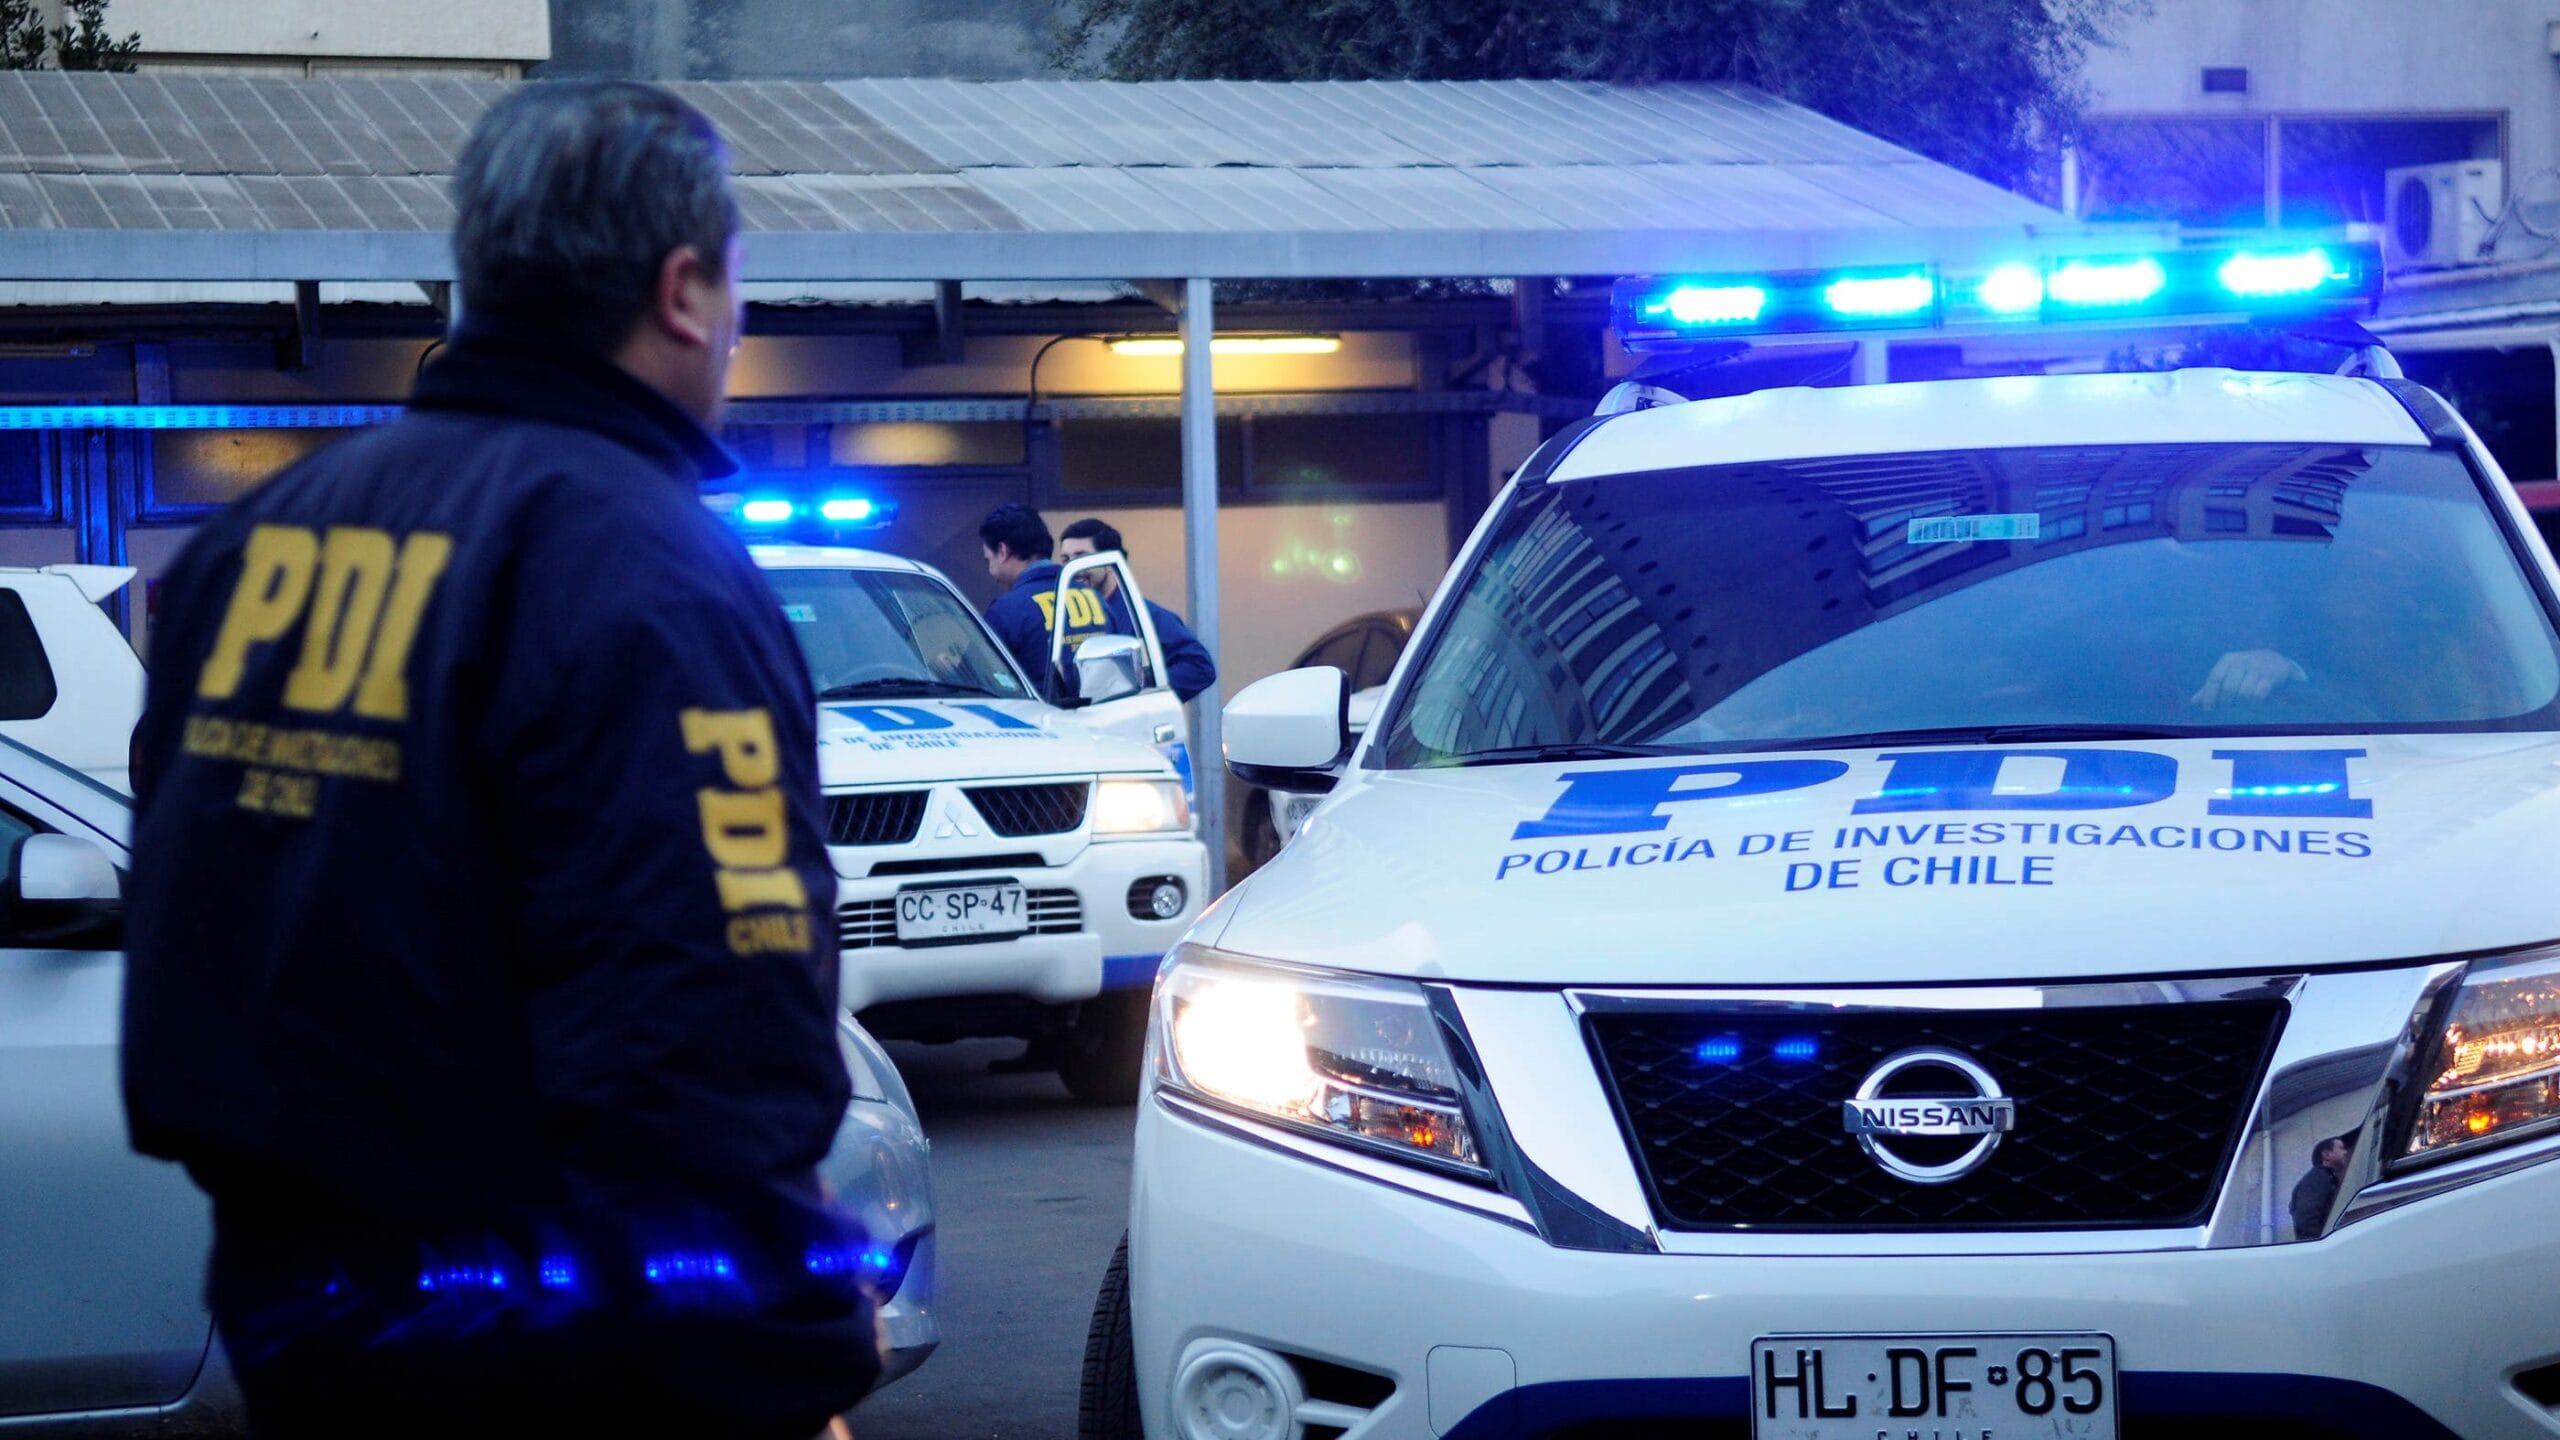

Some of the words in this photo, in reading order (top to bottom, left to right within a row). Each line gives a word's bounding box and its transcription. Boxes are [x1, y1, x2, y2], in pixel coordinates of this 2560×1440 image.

[197, 524, 452, 720] PDI
[822, 704, 1041, 731] DI
[680, 708, 808, 910] PDI
[1510, 746, 2374, 841] PDI
[1495, 835, 1716, 881] POLICÍA
[1738, 829, 1814, 857] DE
[1834, 822, 2373, 858] INVESTIGACIONES
[1784, 859, 1862, 892] DE
[1884, 855, 2055, 886] CHILE
[1862, 1106, 1995, 1128] NISSAN
